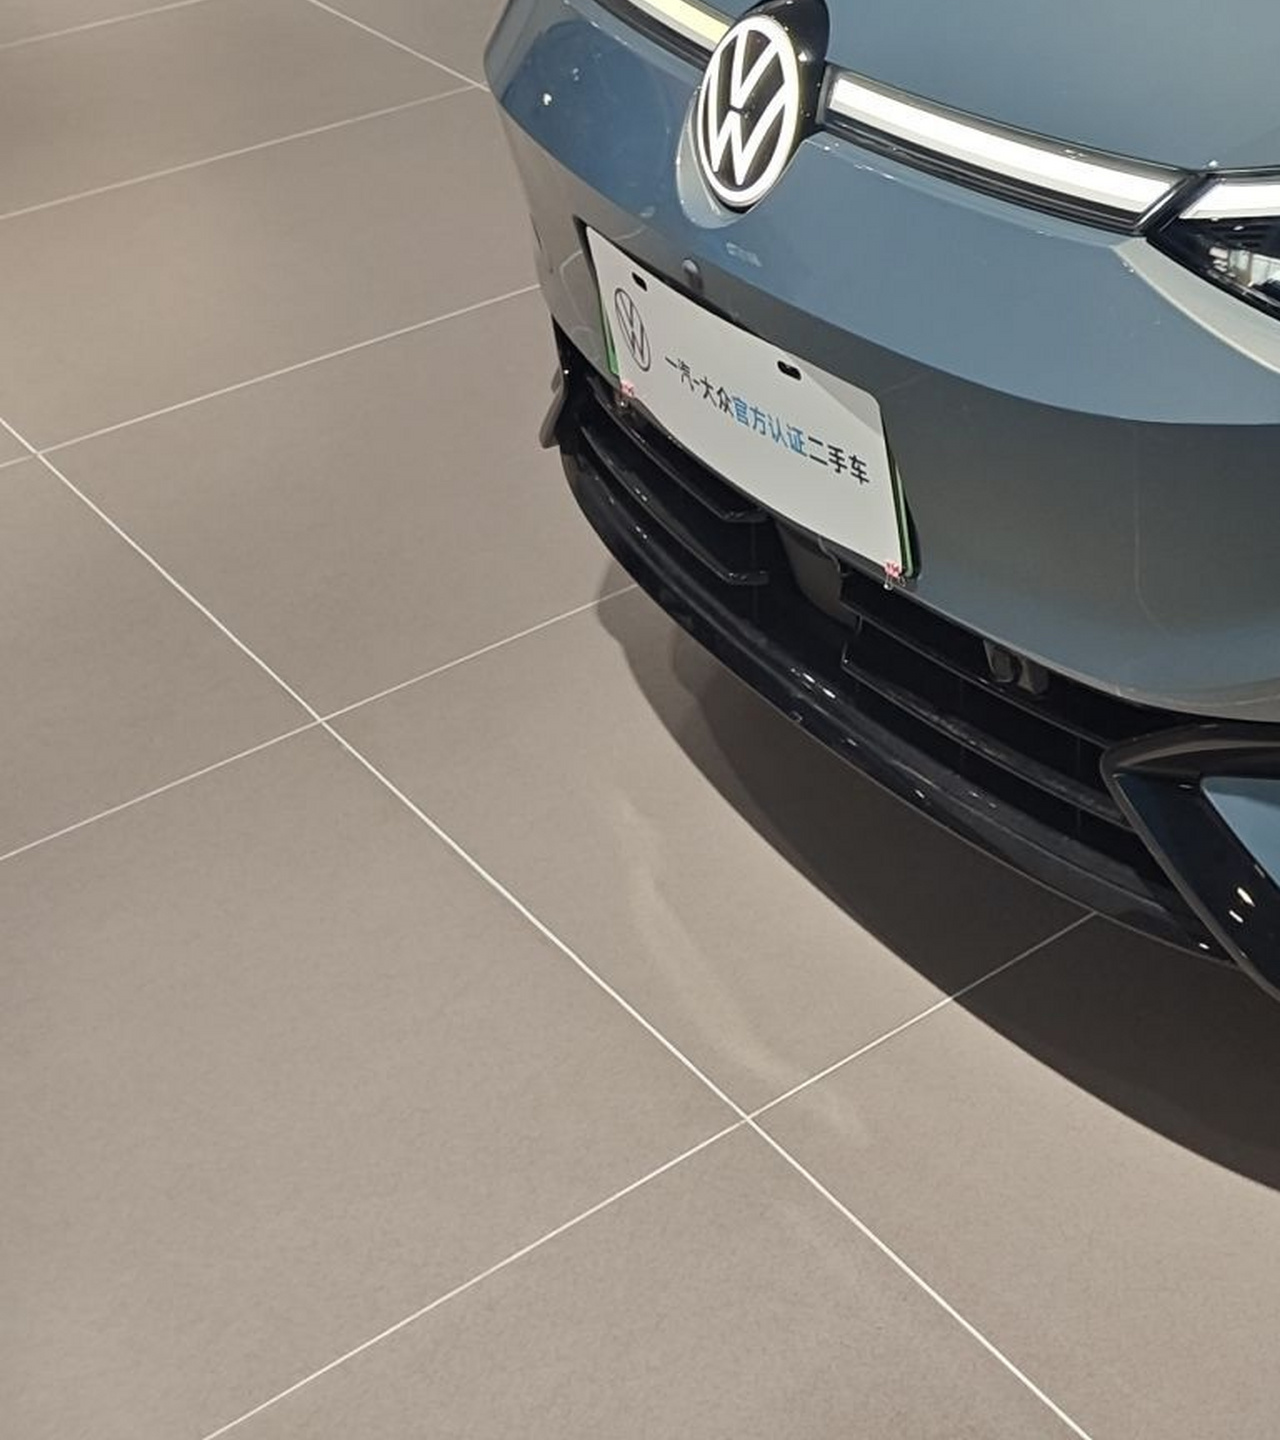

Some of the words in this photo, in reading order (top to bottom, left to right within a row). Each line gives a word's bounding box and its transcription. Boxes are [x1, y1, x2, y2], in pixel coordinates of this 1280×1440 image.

[664, 356, 870, 485] 一汽-大众官方认证二手车
